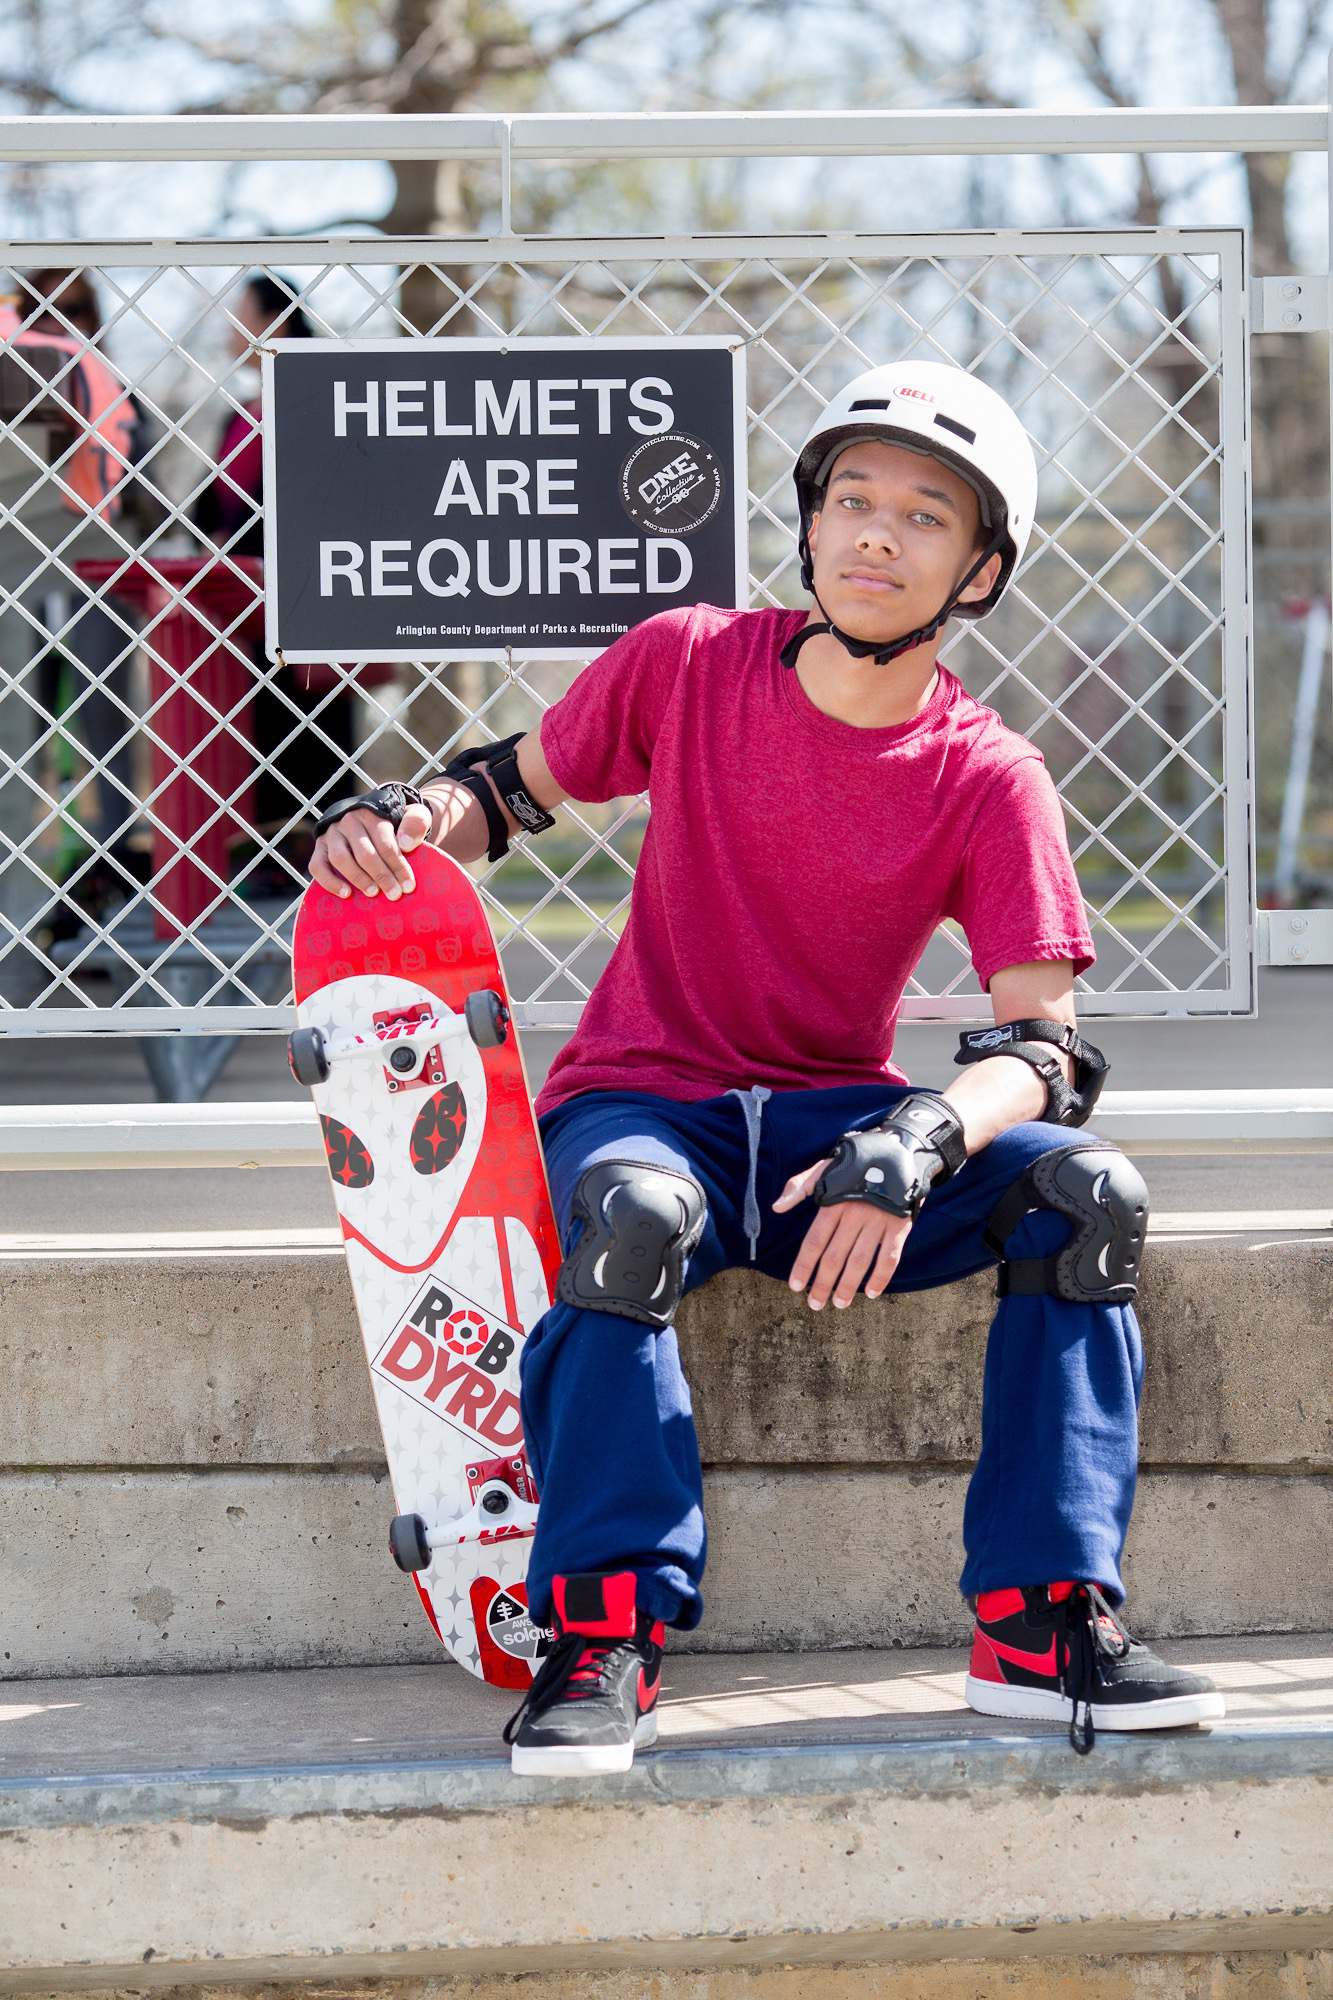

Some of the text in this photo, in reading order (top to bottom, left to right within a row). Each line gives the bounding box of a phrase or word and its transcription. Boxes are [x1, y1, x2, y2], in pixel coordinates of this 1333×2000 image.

[333, 377, 675, 437] HELMETS
[900, 387, 936, 405] BELL
[433, 457, 580, 516] ARE
[622, 435, 701, 502] WWW.ONECOLLECTIVECLOTHING.COM
[638, 451, 700, 504] ONE
[655, 474, 696, 505] Collective
[319, 537, 694, 598] REQUIRED
[395, 623, 629, 637] Arlington County Department of Parks & Recreation
[410, 1285, 515, 1375] ROB
[380, 1323, 527, 1456] DYRD
[502, 1626, 556, 1646] soldie
[512, 1618, 533, 1629] AWS
